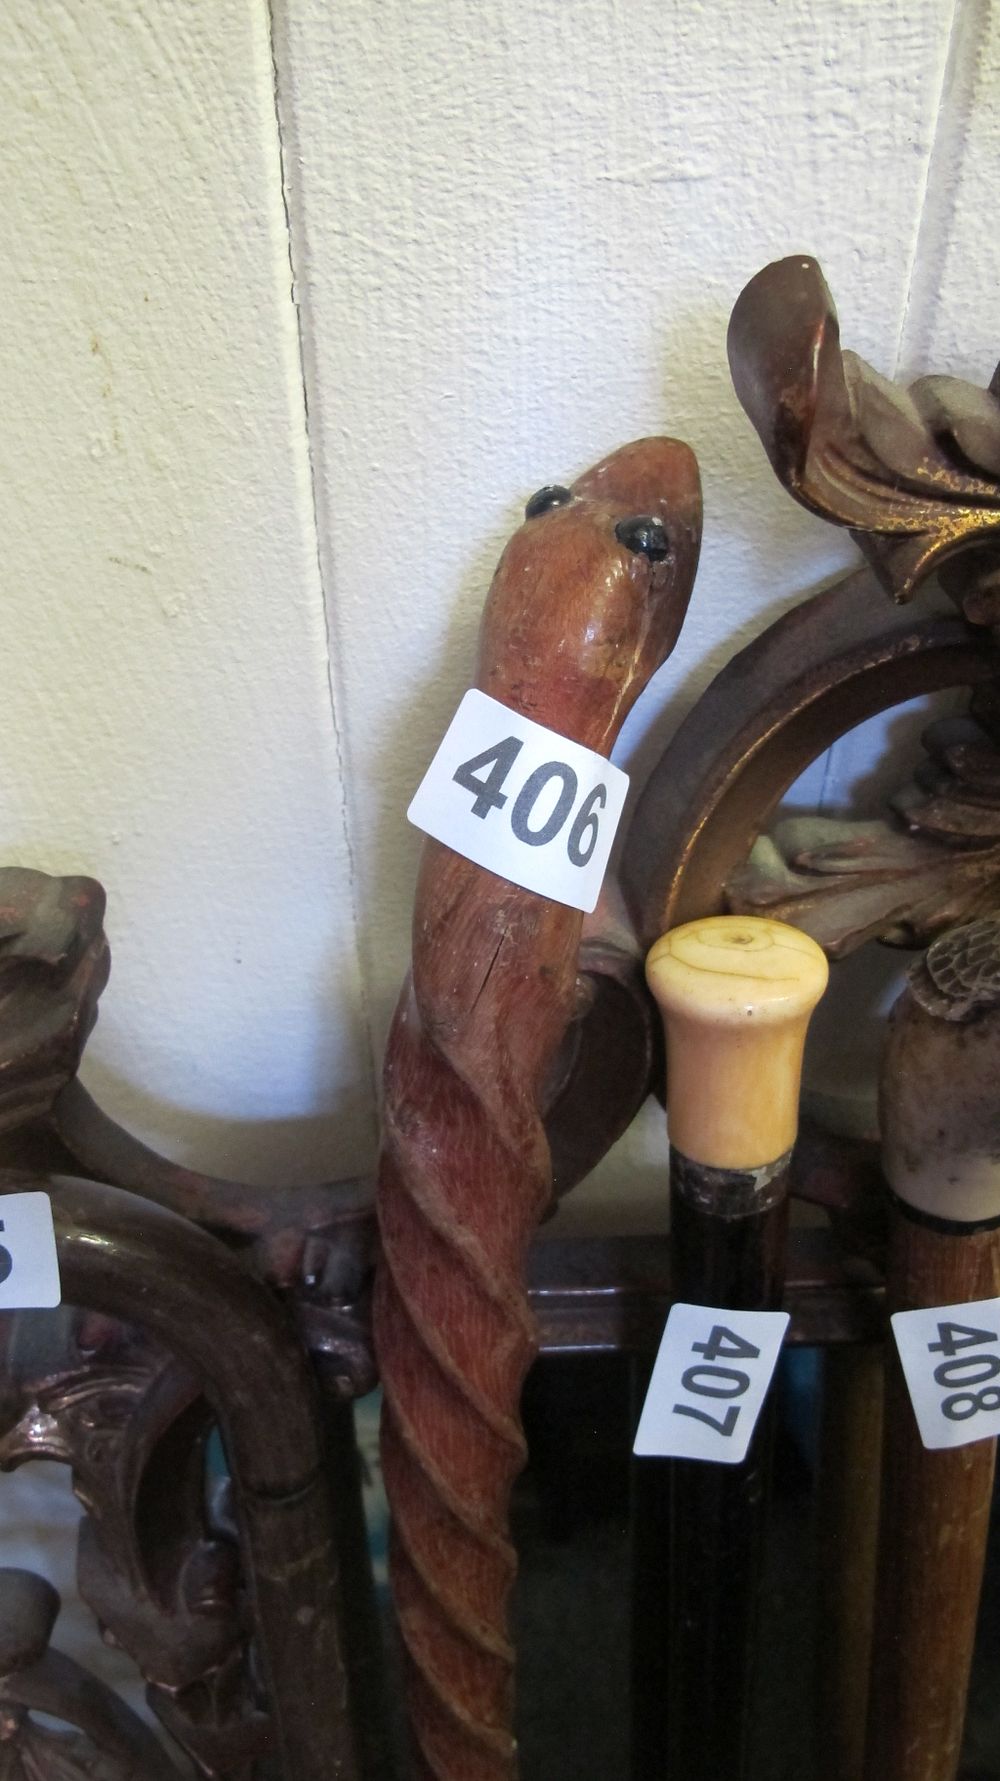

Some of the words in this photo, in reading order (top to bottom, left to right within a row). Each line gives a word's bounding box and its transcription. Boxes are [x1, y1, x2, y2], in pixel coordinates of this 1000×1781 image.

[452, 736, 607, 868] 406
[672, 1325, 761, 1437] 407
[927, 1321, 1000, 1421] 408
